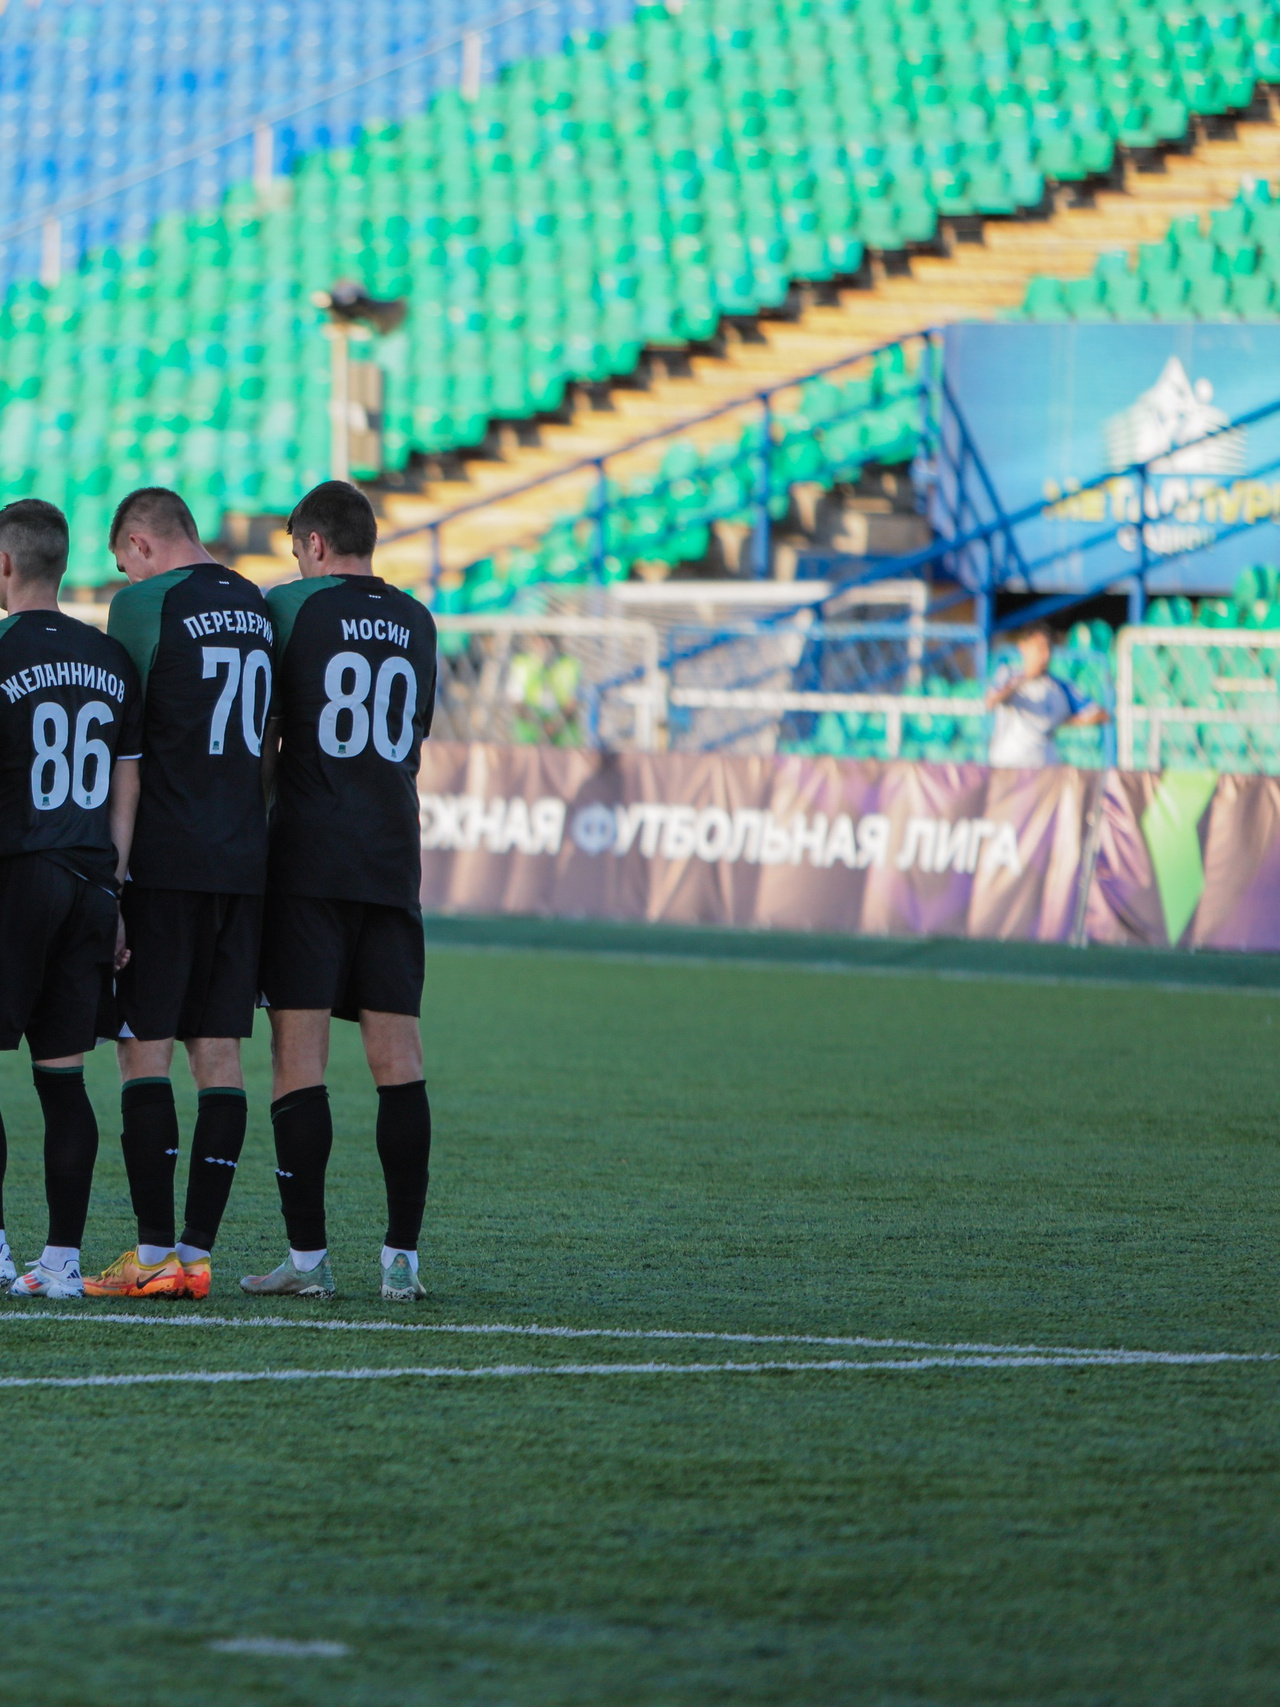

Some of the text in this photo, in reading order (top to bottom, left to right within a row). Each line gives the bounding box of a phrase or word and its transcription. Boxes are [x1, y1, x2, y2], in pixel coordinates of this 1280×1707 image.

[341, 618, 411, 649] МОСИН
[0, 662, 126, 704] ЖЕЛАННИКОВ
[202, 646, 272, 758] 70
[318, 651, 418, 763] 80
[31, 701, 115, 811] 86
[419, 792, 1021, 876] ЖНАЯ ФУТБОЛЬНАЯ ЛИГА
